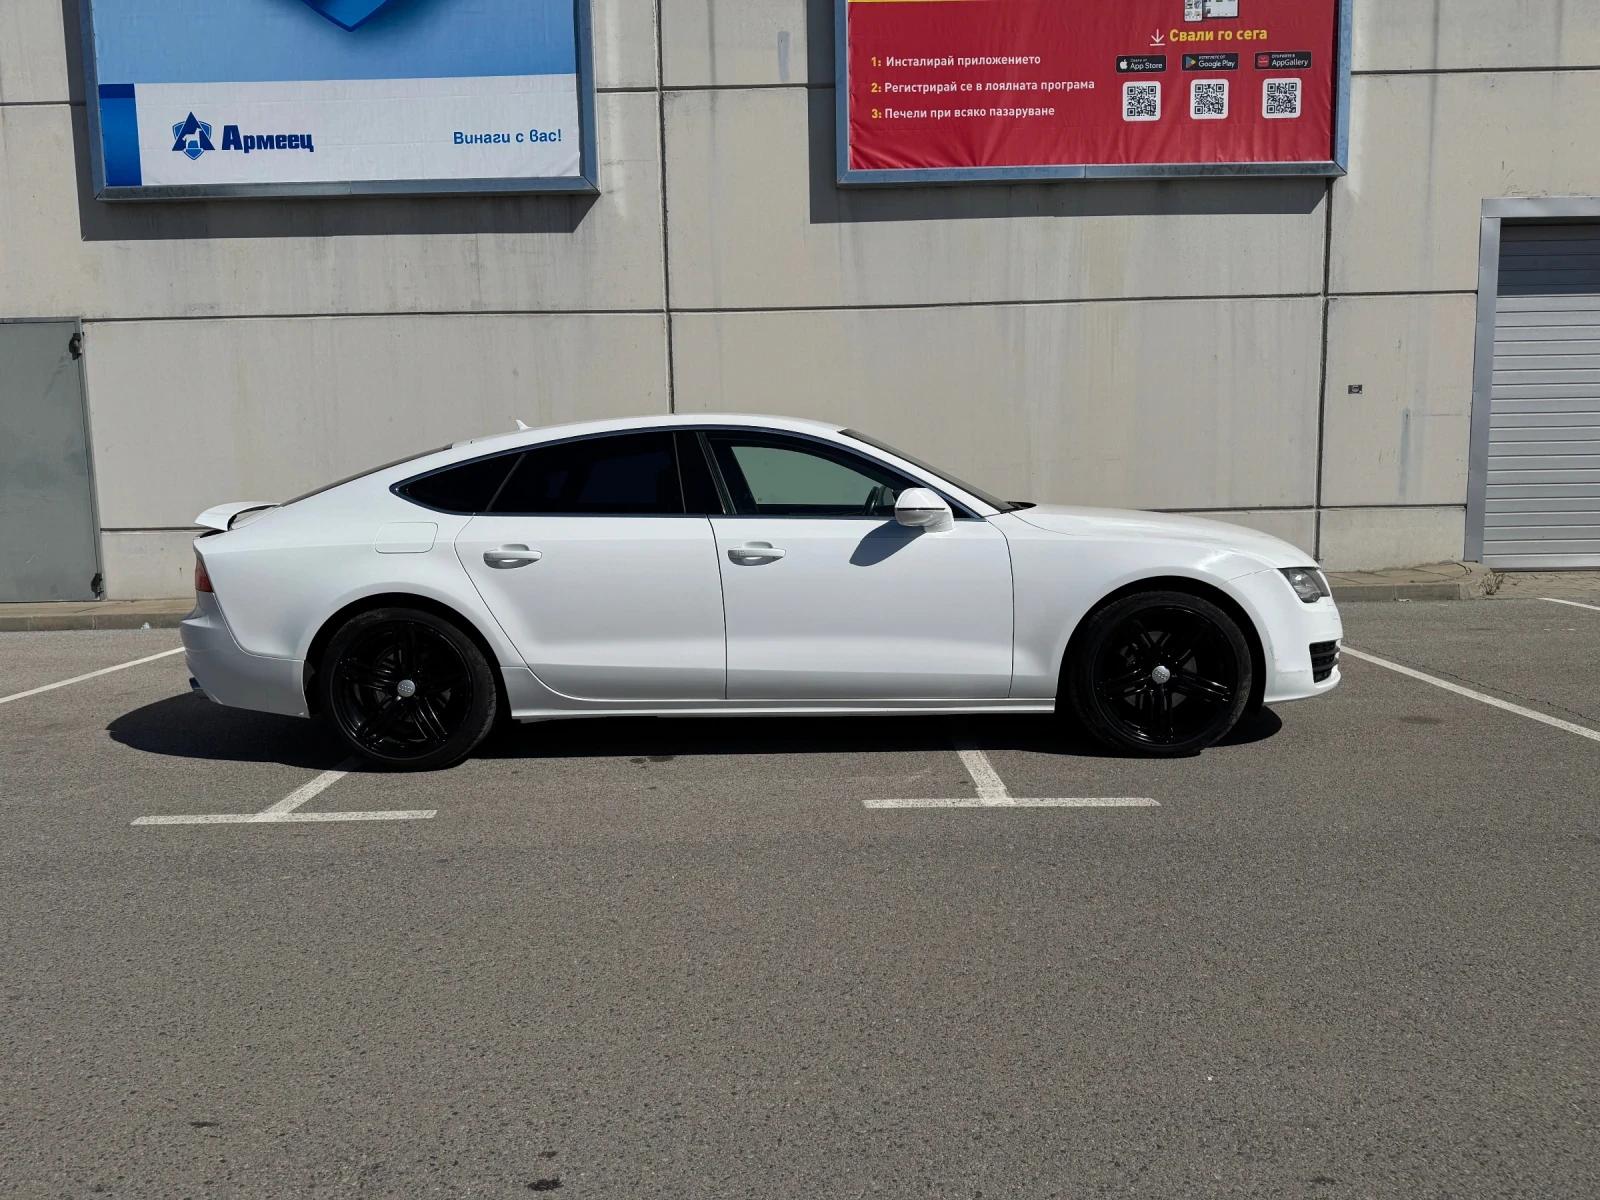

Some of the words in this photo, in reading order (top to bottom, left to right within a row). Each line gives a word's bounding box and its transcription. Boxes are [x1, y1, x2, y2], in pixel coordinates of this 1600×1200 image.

[1170, 29, 1213, 41] Свали
[1218, 31, 1232, 40] го
[1237, 30, 1267, 40] сега
[887, 56, 954, 68] Инсталирай
[958, 56, 1041, 67] приложението
[1199, 60, 1221, 68] Google
[1222, 60, 1235, 68] Play
[1271, 58, 1308, 67] AppGallery
[885, 82, 956, 94] Регистрирай
[960, 83, 973, 92] се
[976, 83, 983, 91] в
[1041, 81, 1094, 92] програма
[885, 109, 926, 118] Печели
[931, 110, 950, 119] при
[955, 109, 987, 118] всяко
[990, 108, 1054, 118] пазаруване
[222, 125, 314, 153] Армеец
[454, 132, 510, 144] Винаги
[515, 133, 524, 142] с
